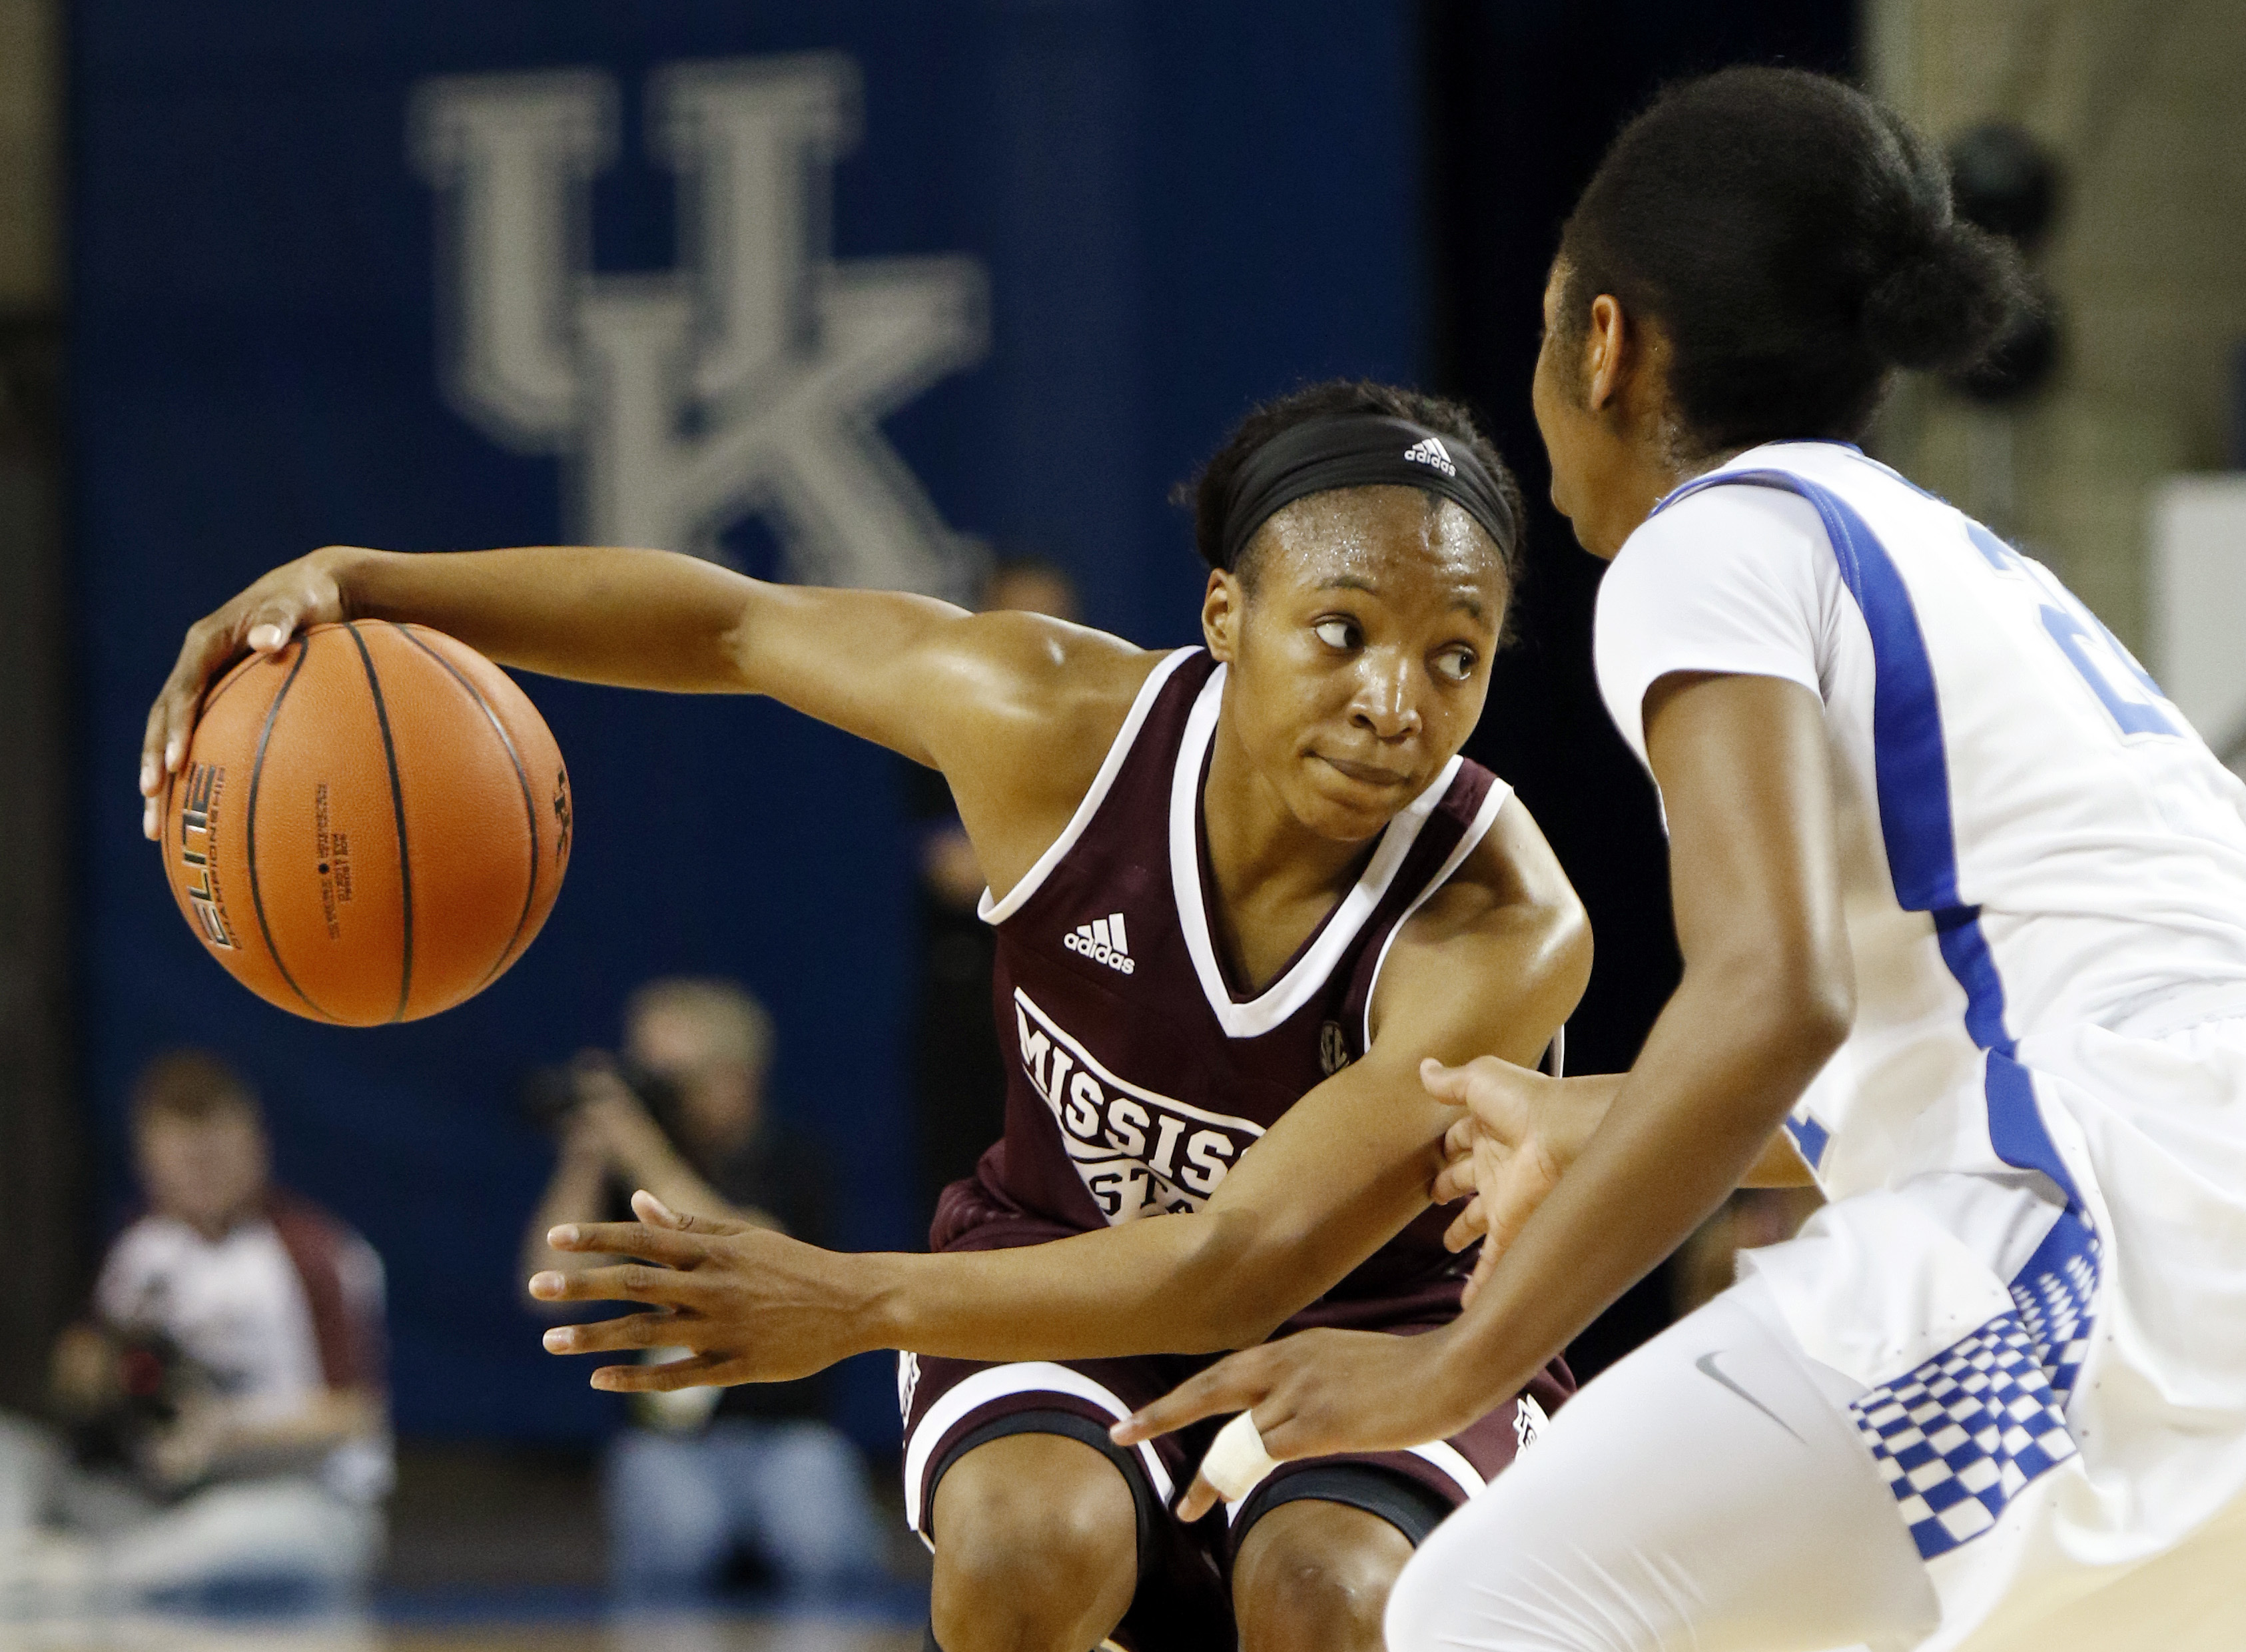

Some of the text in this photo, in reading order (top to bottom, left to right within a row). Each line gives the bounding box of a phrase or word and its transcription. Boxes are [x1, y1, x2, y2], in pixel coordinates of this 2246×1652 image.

[408, 55, 988, 609] UK
[1404, 449, 1457, 477] adidas
[182, 762, 233, 949] ELITE
[1064, 932, 1135, 975] adidas
[1014, 1001, 1252, 1196] MISSIS
